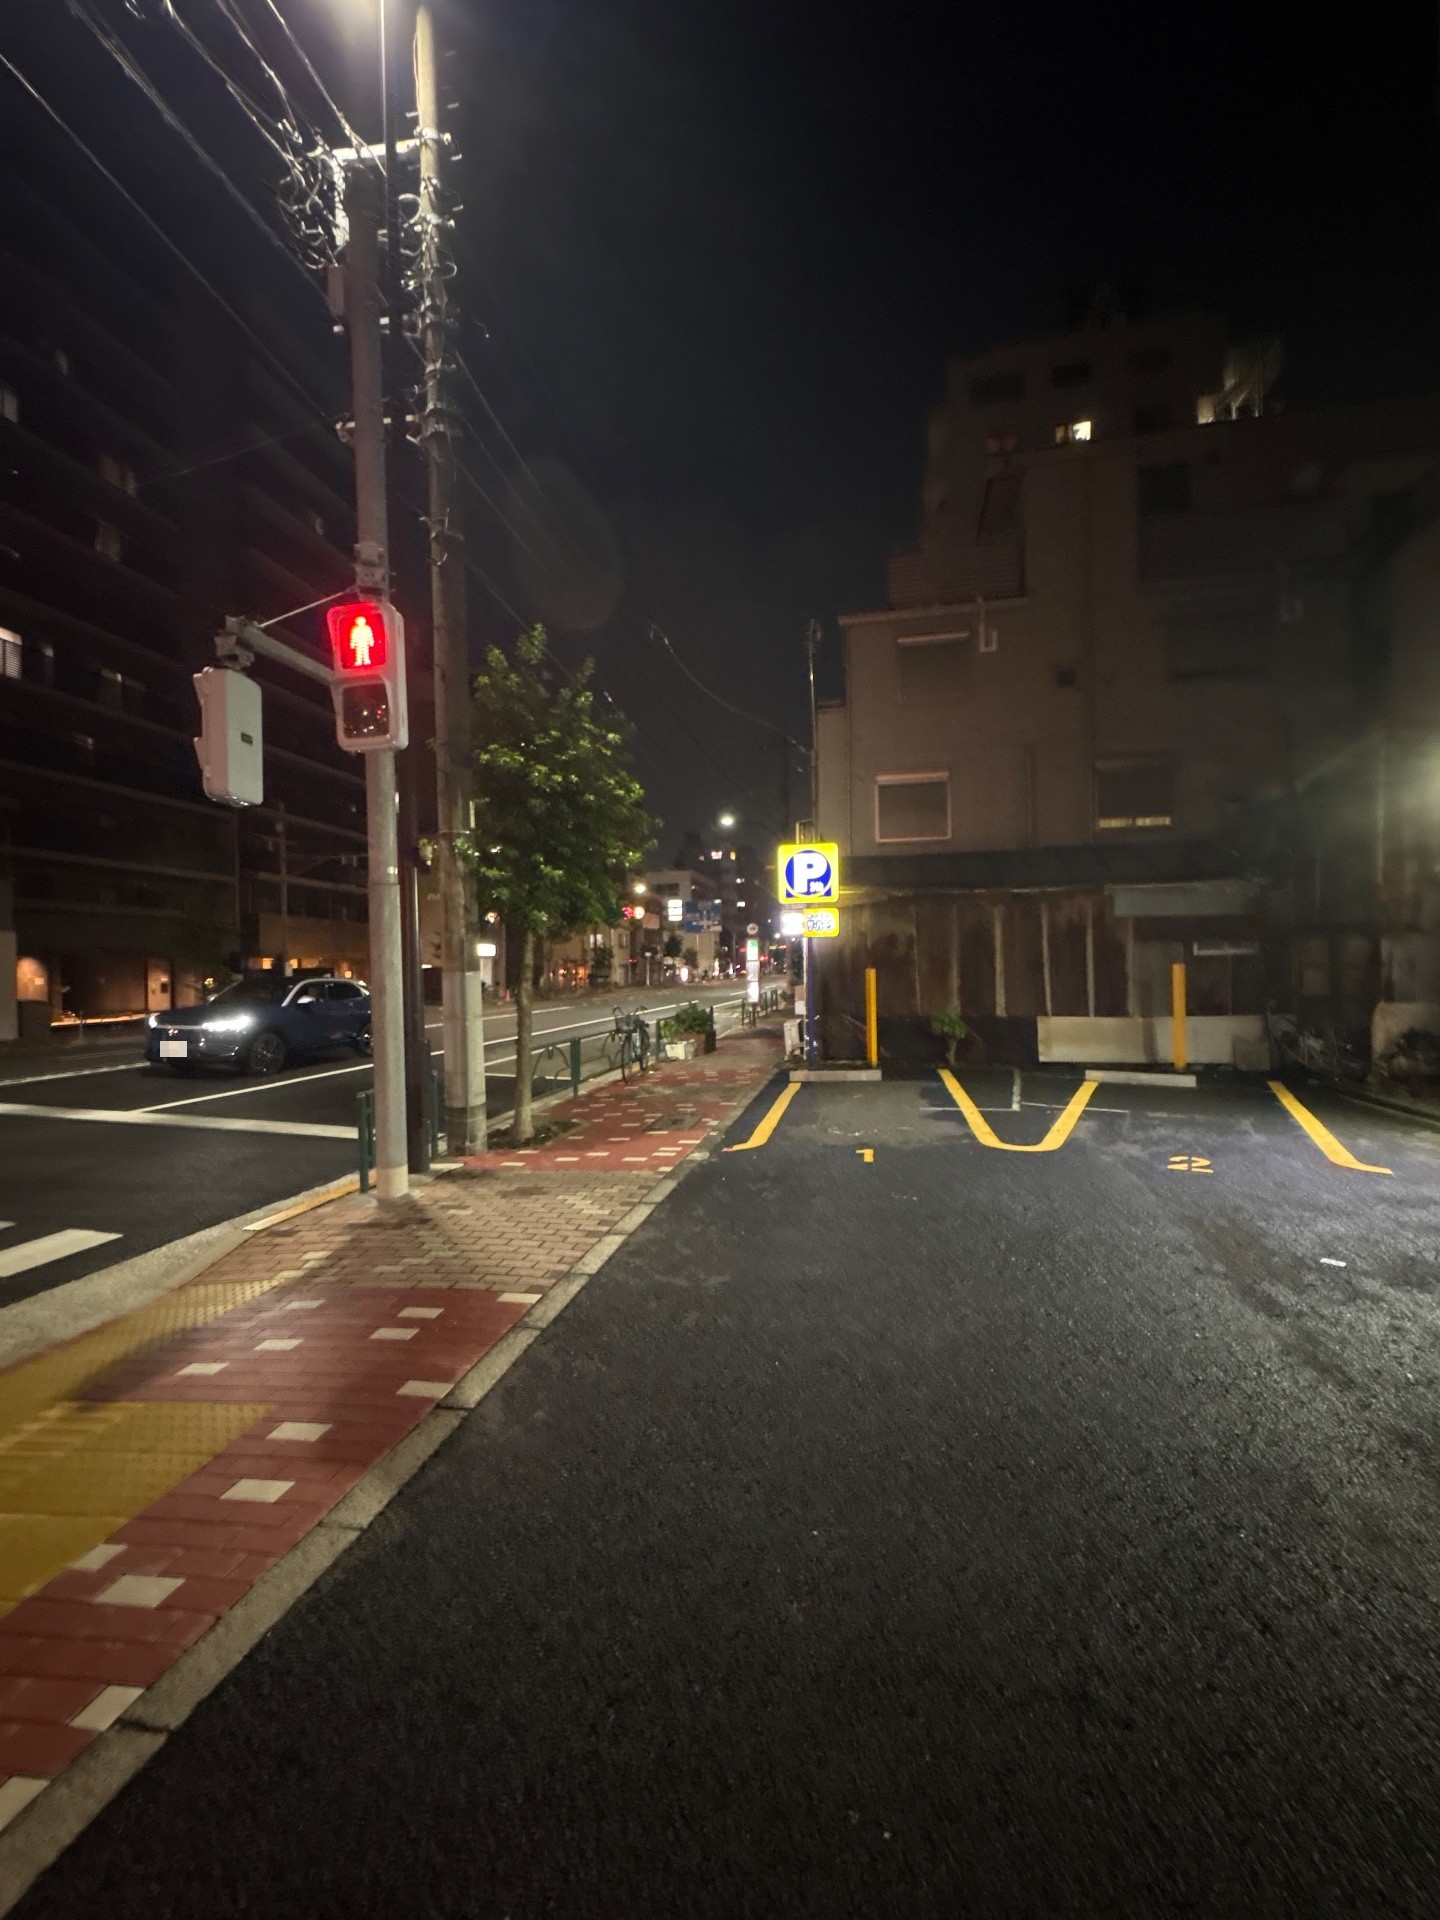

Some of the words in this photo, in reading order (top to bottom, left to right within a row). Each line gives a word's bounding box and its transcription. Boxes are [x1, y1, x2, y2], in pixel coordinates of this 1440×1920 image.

[793, 852, 828, 892] P
[856, 1148, 874, 1163] 1
[1167, 1156, 1213, 1174] 2
